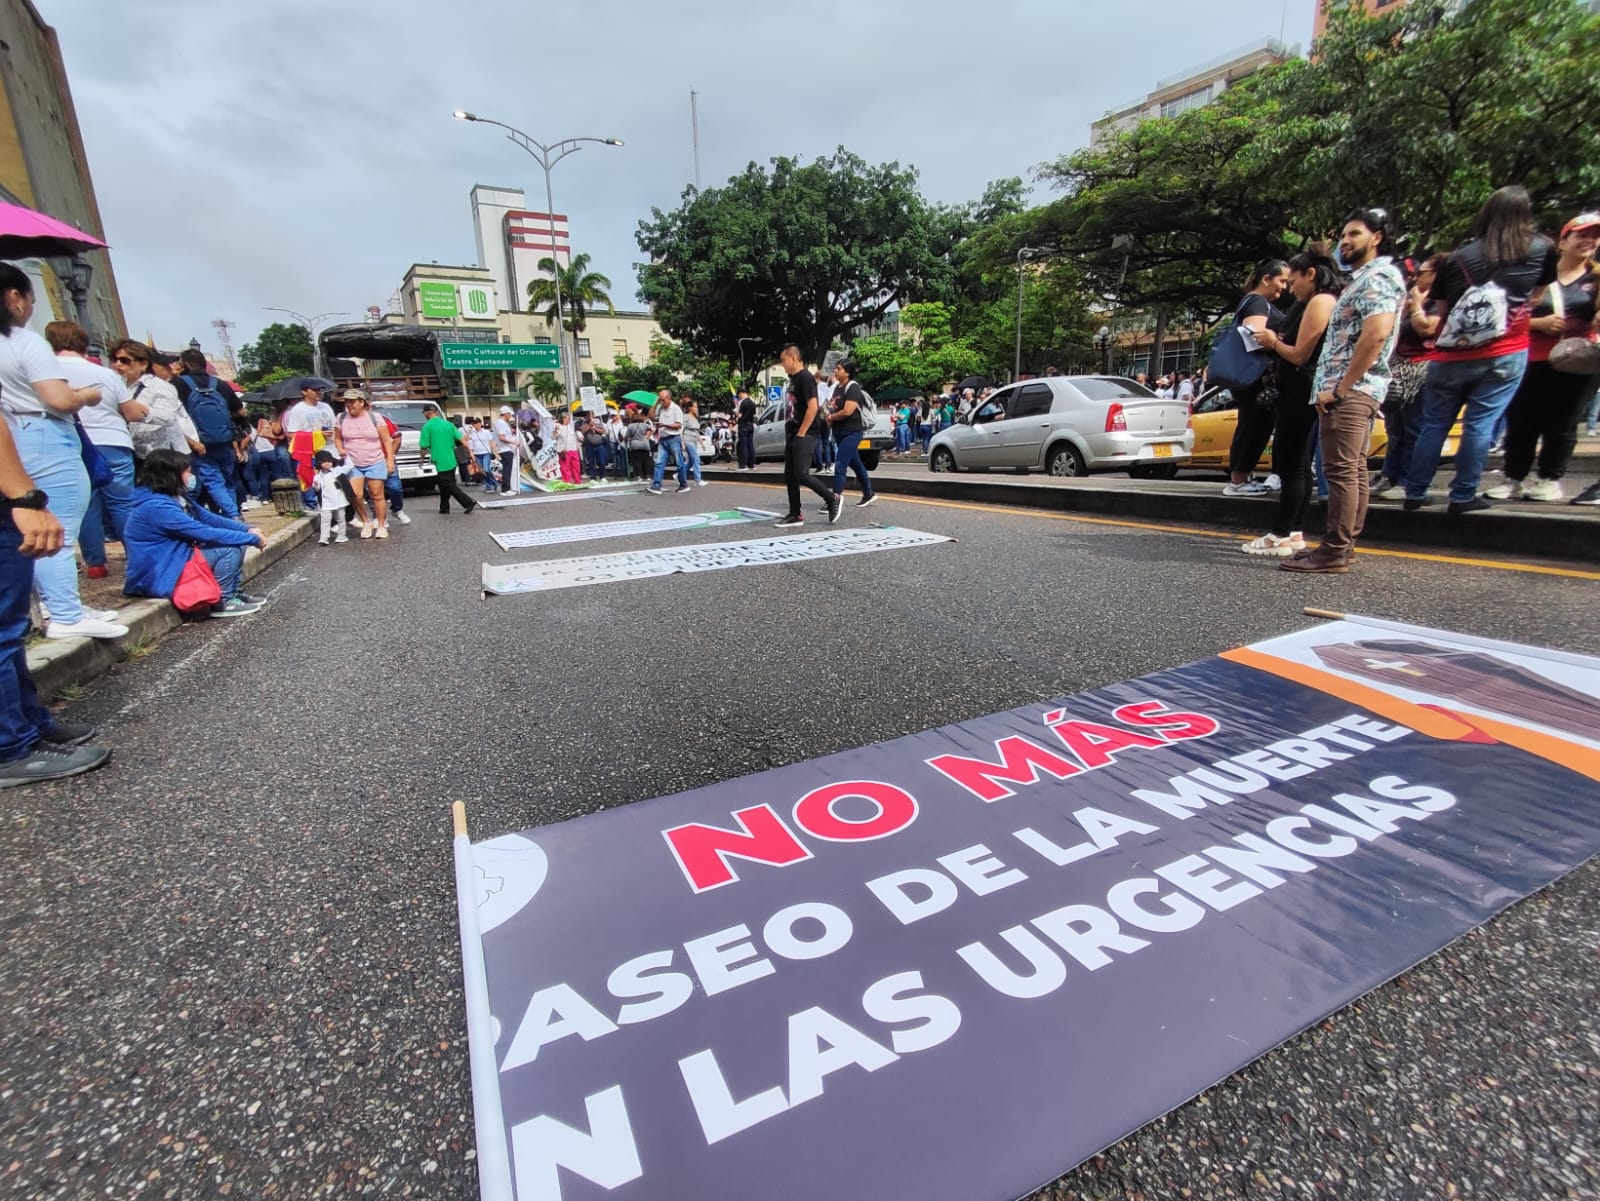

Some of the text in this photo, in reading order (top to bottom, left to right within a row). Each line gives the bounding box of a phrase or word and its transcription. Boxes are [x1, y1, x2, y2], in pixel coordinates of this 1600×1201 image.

[447, 357, 472, 365] Teatro
[519, 348, 547, 356] Oriente
[743, 551, 820, 563] ABRIL
[825, 545, 864, 553] DE
[865, 537, 936, 548] 2024
[661, 700, 1221, 894] NO MÁS
[490, 712, 1416, 1073] ASEO DE LA MUERTE
[677, 970, 961, 1146] LAS
[955, 775, 1458, 999] URGENCIAS
